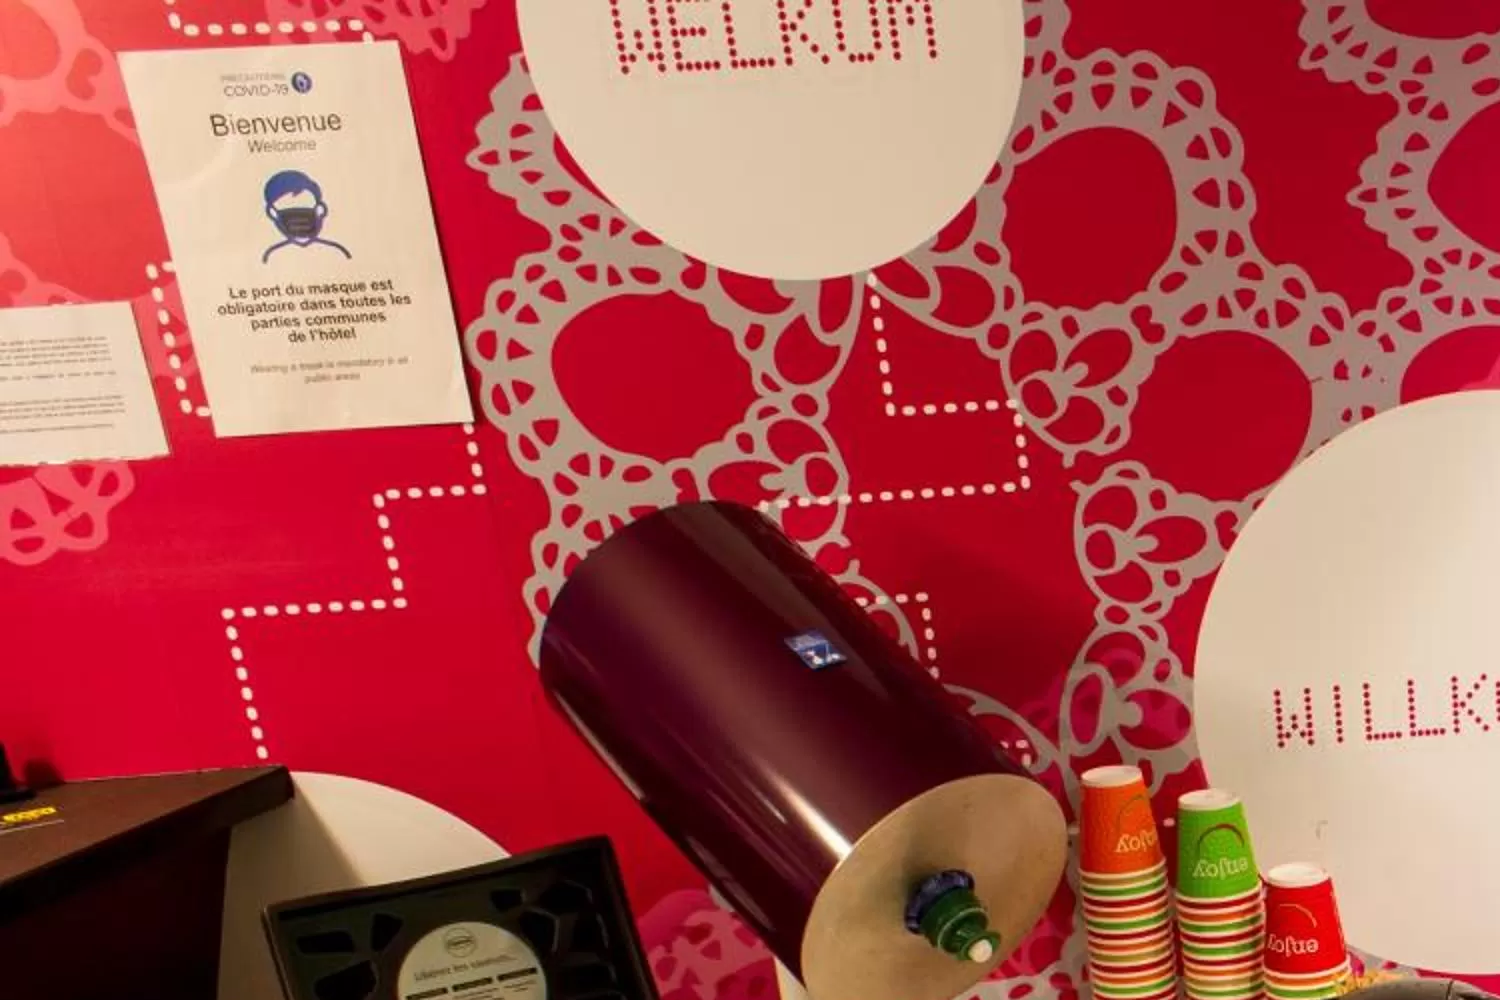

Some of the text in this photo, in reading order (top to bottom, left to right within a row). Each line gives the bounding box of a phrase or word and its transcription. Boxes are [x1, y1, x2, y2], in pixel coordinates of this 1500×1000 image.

[223, 83, 289, 97] COVID-19
[209, 112, 342, 137] Bienvenue
[247, 139, 317, 153] Welcome
[228, 278, 395, 300] Le port du masque est
[217, 293, 412, 317] obligatoire dans toutes les
[251, 311, 387, 331] parties communes
[287, 330, 306, 343] de
[1192, 856, 1249, 880] enjoy
